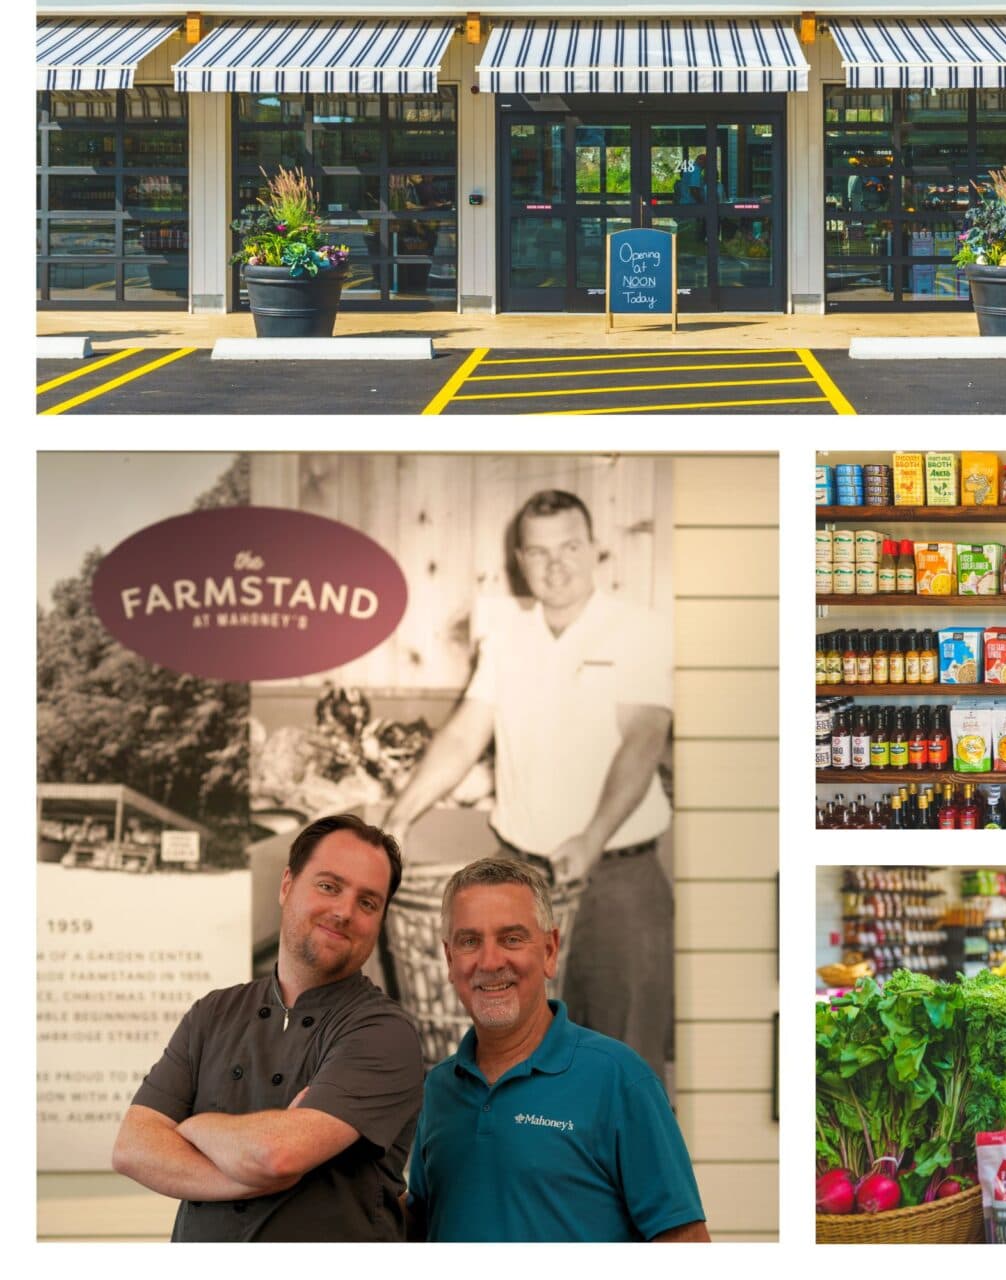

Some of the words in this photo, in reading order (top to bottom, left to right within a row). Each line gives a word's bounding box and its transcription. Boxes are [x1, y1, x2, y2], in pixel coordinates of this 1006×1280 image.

[673, 159, 695, 173] 248
[619, 242, 661, 267] Opening
[633, 261, 647, 273] at
[622, 275, 656, 287] NOON
[622, 291, 658, 309] Today
[234, 550, 265, 570] the
[121, 575, 379, 619] FARMSTAND
[193, 615, 210, 628] AT
[216, 614, 308, 630] MAHONEY'S
[47, 919, 93, 933] 1959
[150, 952, 203, 961] CENTER
[63, 991, 145, 1001] CHRISTMAS
[108, 1032, 159, 1041] STREET
[524, 1114, 574, 1131] Mahoney's
